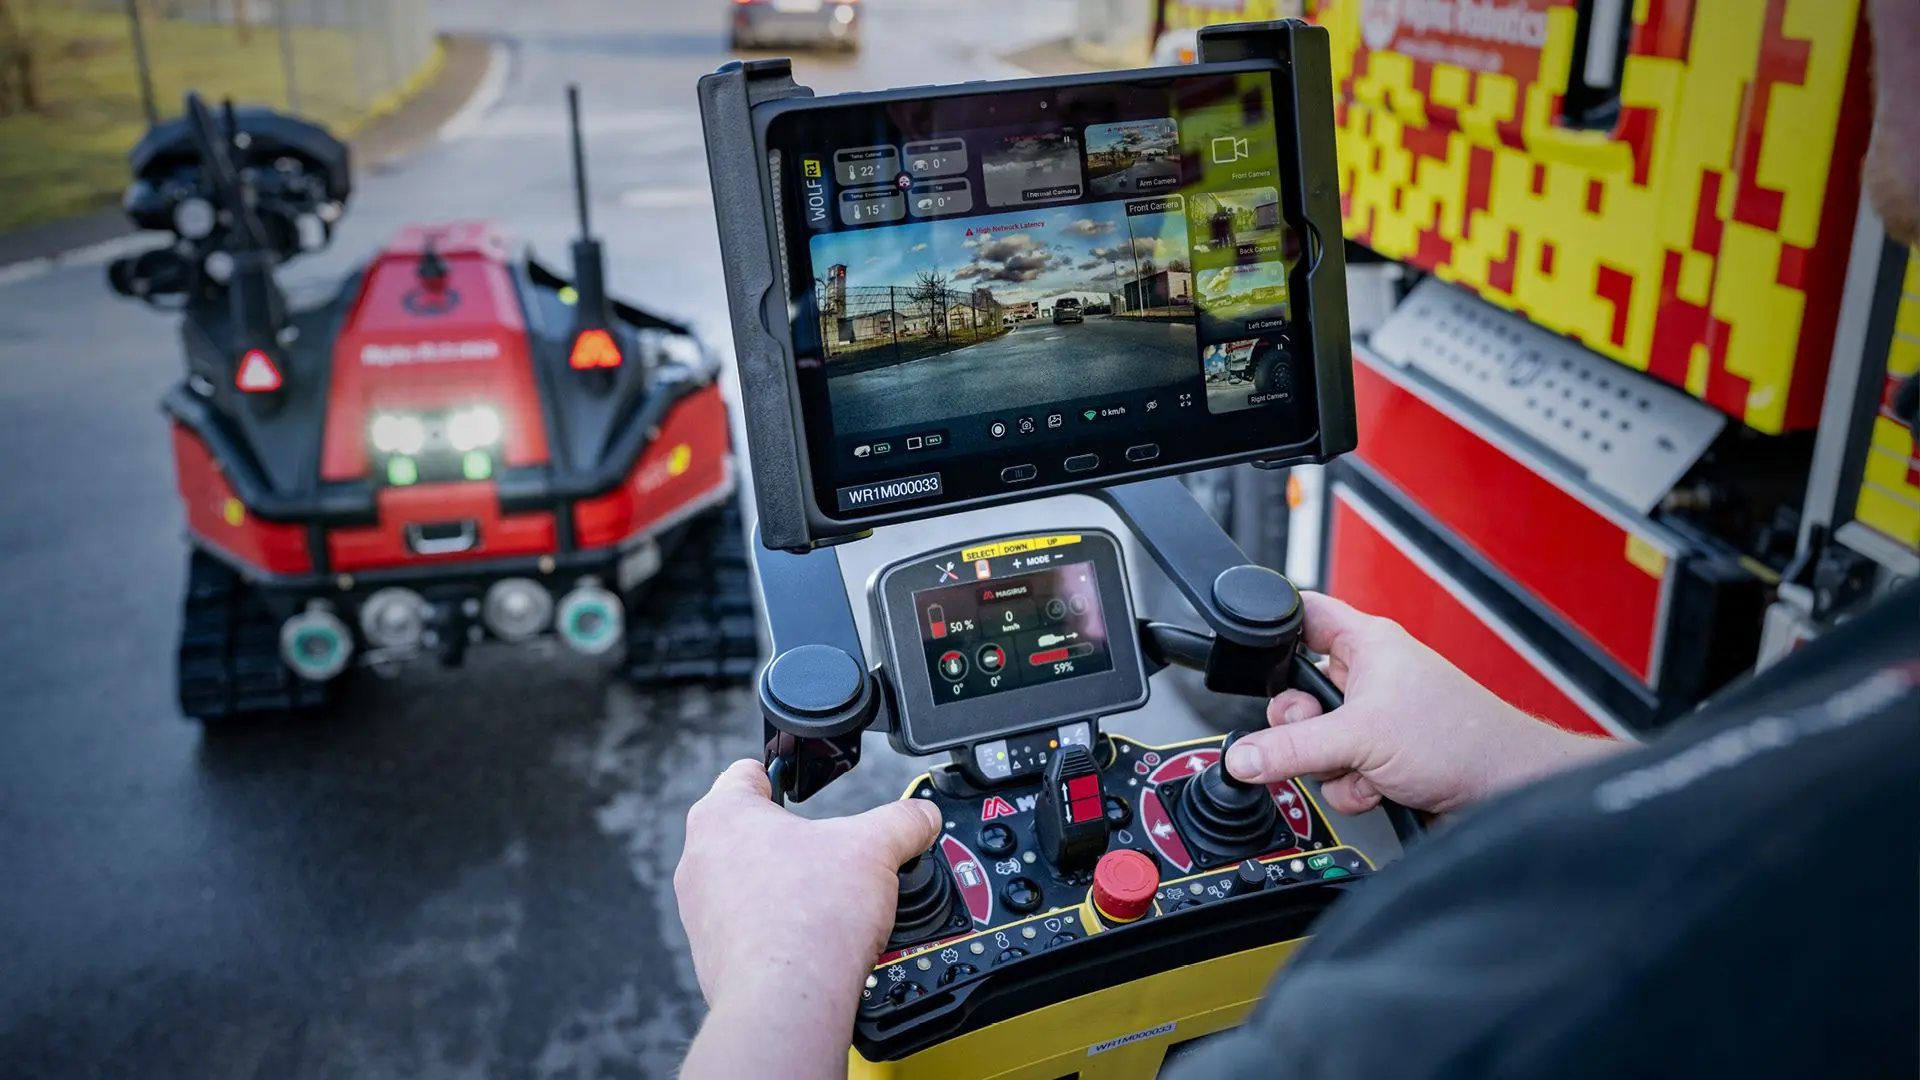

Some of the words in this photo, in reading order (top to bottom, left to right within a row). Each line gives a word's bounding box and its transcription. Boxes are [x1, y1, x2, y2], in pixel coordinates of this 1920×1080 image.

[807, 162, 817, 176] R1
[1231, 171, 1247, 180] Front
[1247, 169, 1271, 179] Camera
[1139, 179, 1153, 188] Arm
[1153, 177, 1177, 186] Camera
[1026, 189, 1052, 199] Thermal
[1052, 187, 1077, 197] Camera
[806, 179, 826, 222] WOLF
[1129, 202, 1149, 214] Front
[1150, 199, 1179, 212] Camera
[1020, 220, 1046, 230] Latency
[1239, 248, 1254, 256] Back
[1254, 245, 1277, 254] Camera
[1248, 321, 1261, 330] Left
[1260, 319, 1283, 329] Camera
[1250, 394, 1267, 405] Right
[1266, 392, 1289, 402] Camera
[1107, 406, 1126, 416] km/h
[848, 477, 939, 505] WR1M000033
[1047, 538, 1058, 546] UP
[966, 548, 995, 561] SELECT
[1003, 543, 1028, 555] DOWN
[1026, 554, 1050, 567] MODE
[995, 586, 1028, 598] MAGIRUS
[1005, 610, 1014, 623] 0
[950, 622, 963, 633] 50
[1002, 623, 1020, 632] km/h
[1053, 661, 1075, 676] 59%
[1095, 1023, 1173, 1052] WR1M000033
